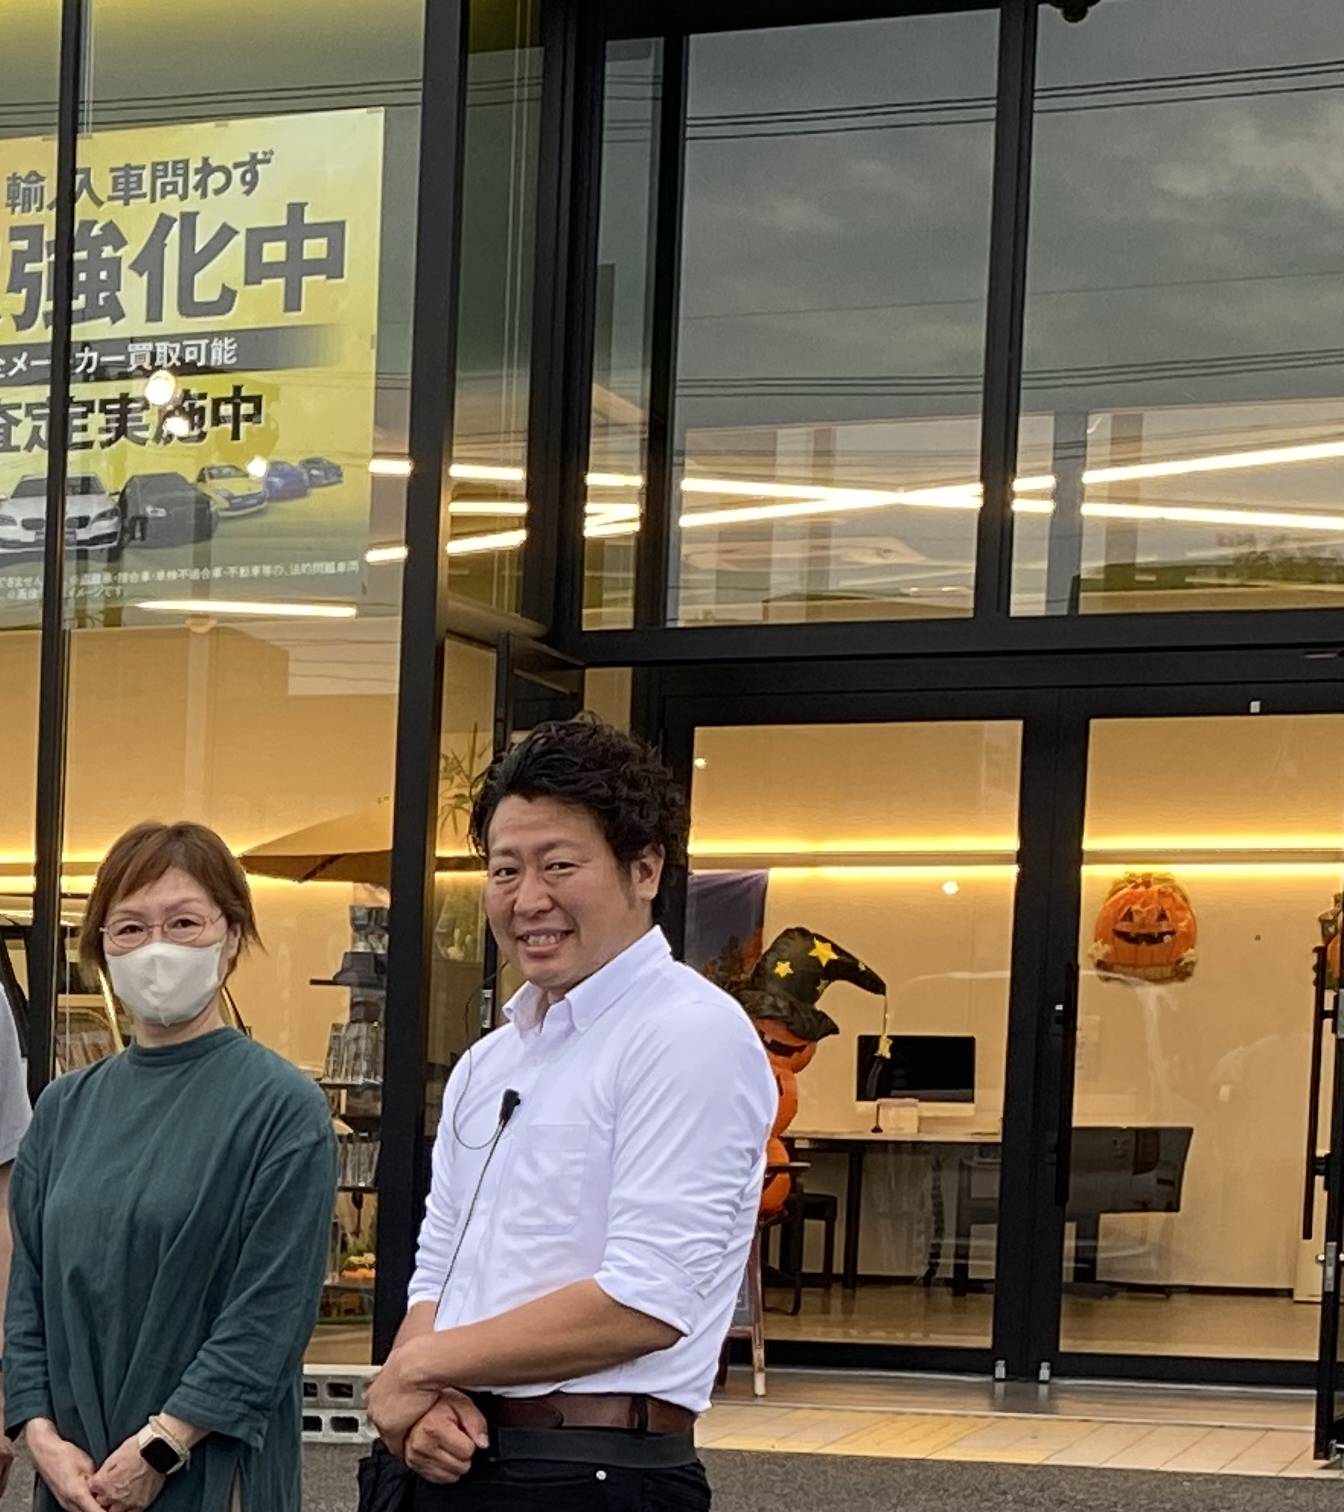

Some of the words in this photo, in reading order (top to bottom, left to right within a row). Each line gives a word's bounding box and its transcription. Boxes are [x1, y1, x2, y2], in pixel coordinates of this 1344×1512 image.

[5, 149, 274, 214] 輸入車問わず
